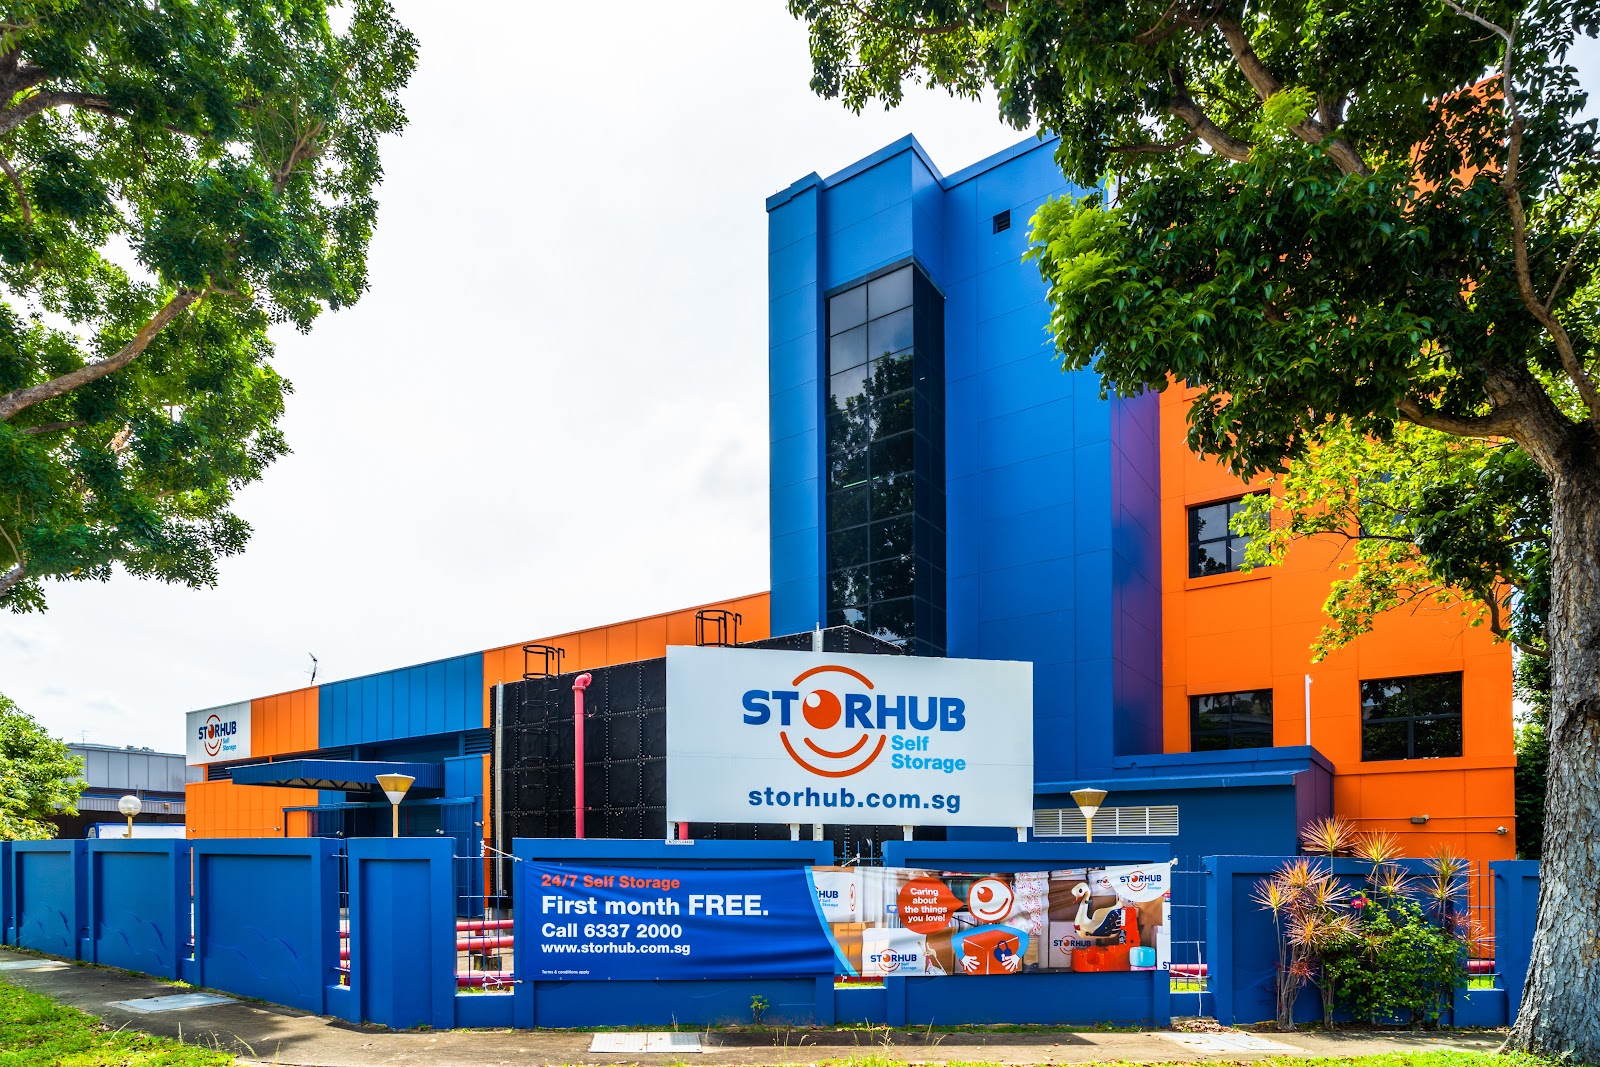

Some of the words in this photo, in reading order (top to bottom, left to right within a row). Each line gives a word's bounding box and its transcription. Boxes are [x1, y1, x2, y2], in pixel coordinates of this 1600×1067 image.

[742, 689, 966, 732] STORHUB
[198, 720, 236, 740] STORHUB
[891, 735, 929, 752] Self
[891, 753, 966, 774] Storage
[748, 787, 961, 813] storhub.com.sg
[541, 874, 578, 887] 24/7
[583, 875, 614, 888] Self
[619, 876, 680, 891] Storage
[1119, 874, 1162, 883] STORHUB
[816, 890, 839, 899] HUB
[910, 887, 939, 897] Caring
[542, 895, 598, 915] First
[605, 897, 680, 915] month
[688, 894, 769, 916] FREE.
[912, 896, 937, 904] about
[904, 905, 920, 913] the
[921, 905, 948, 915] things
[908, 914, 924, 923] you
[926, 914, 946, 922] love!
[542, 922, 578, 938] Call
[584, 924, 630, 938] 6337
[636, 924, 682, 938] 2000
[541, 942, 690, 956] www.storhub.com.sg
[1053, 939, 1091, 947] STORHUB
[870, 954, 917, 963] STORHUB
